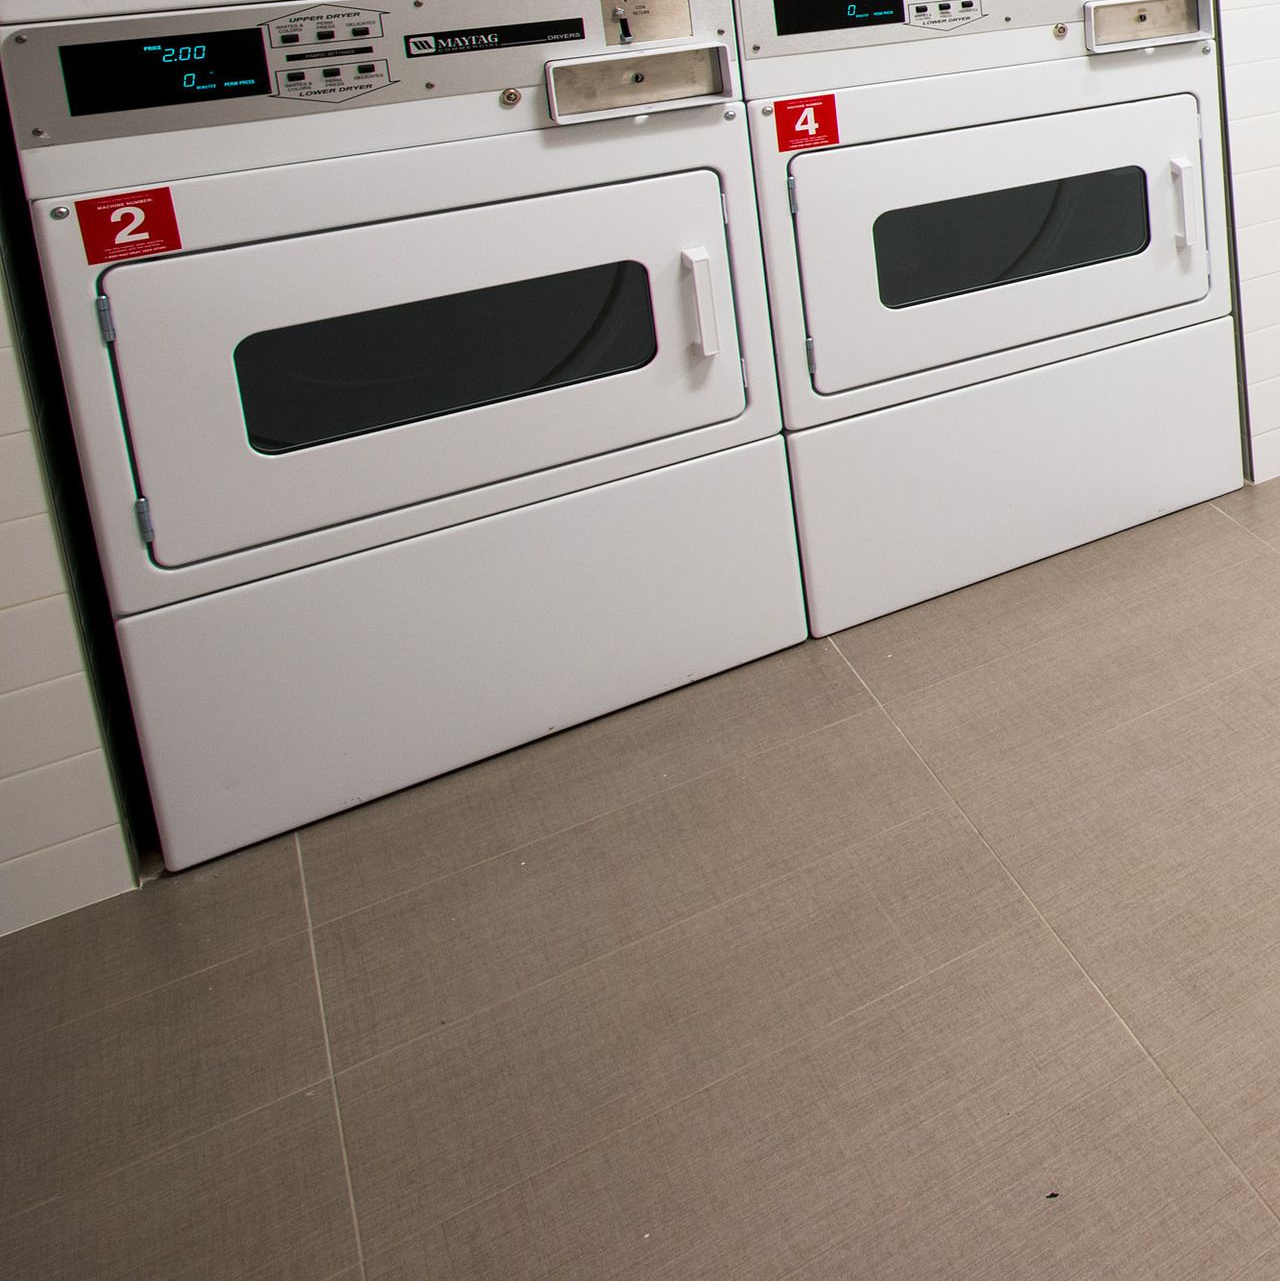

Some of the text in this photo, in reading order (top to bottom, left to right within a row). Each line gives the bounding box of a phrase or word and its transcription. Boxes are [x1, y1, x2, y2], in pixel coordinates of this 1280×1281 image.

[848, 4, 856, 16] 0
[289, 12, 360, 23] UPPER DRYER
[438, 33, 499, 48] MAYTAG
[547, 32, 581, 41] DRYERS
[163, 45, 206, 63] 2.00
[183, 73, 195, 87] 0
[299, 84, 373, 97] LOWER DRYER
[795, 107, 819, 135] 4
[111, 206, 150, 244] 2
